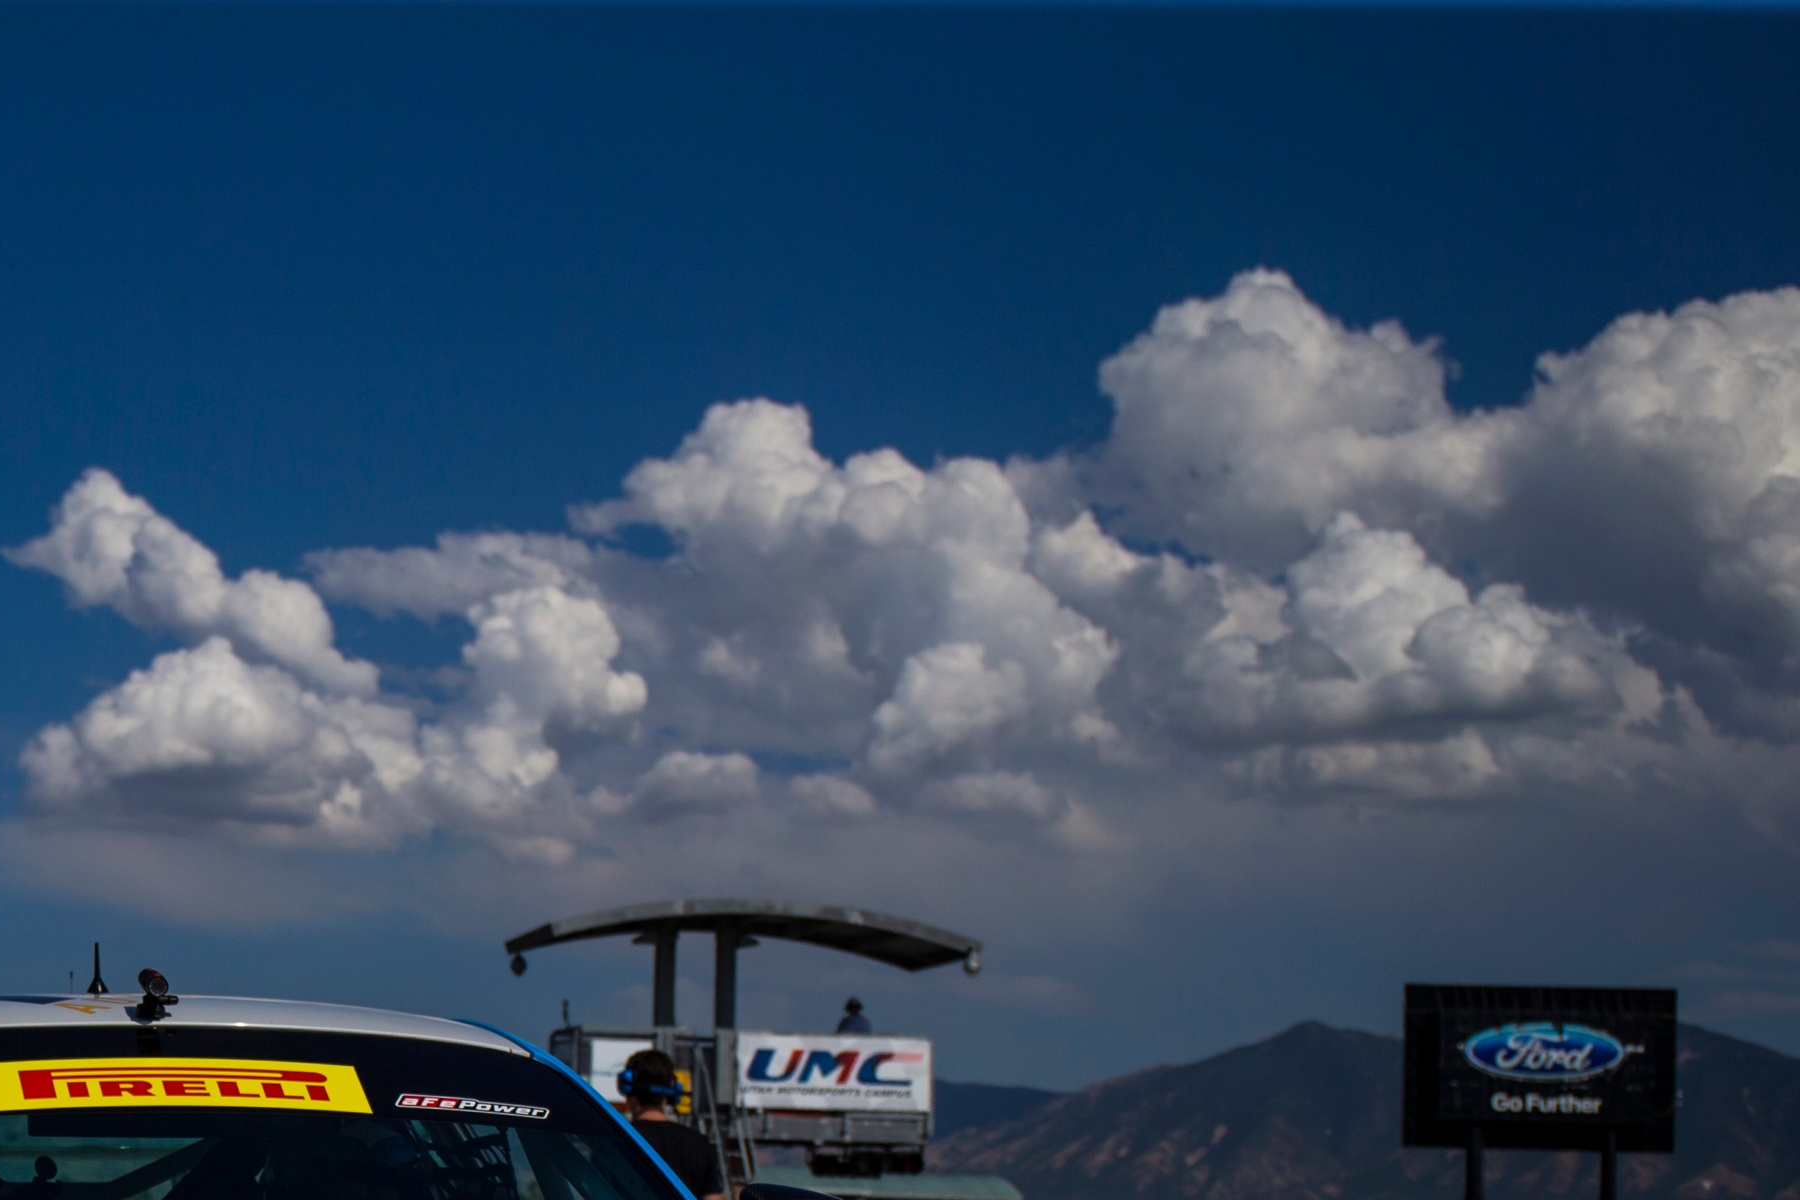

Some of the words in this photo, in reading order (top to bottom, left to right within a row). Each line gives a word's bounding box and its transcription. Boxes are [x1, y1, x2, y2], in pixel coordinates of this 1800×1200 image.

[1494, 1031, 1596, 1071] Ford
[747, 1048, 924, 1085] UMC
[18, 1066, 331, 1102] PIRELLI
[777, 1086, 862, 1098] MOTORSPORTS
[865, 1089, 912, 1099] CAMPUS
[401, 1097, 545, 1117] aFePower
[1491, 1092, 1524, 1114] Go
[1526, 1091, 1603, 1115] Further
